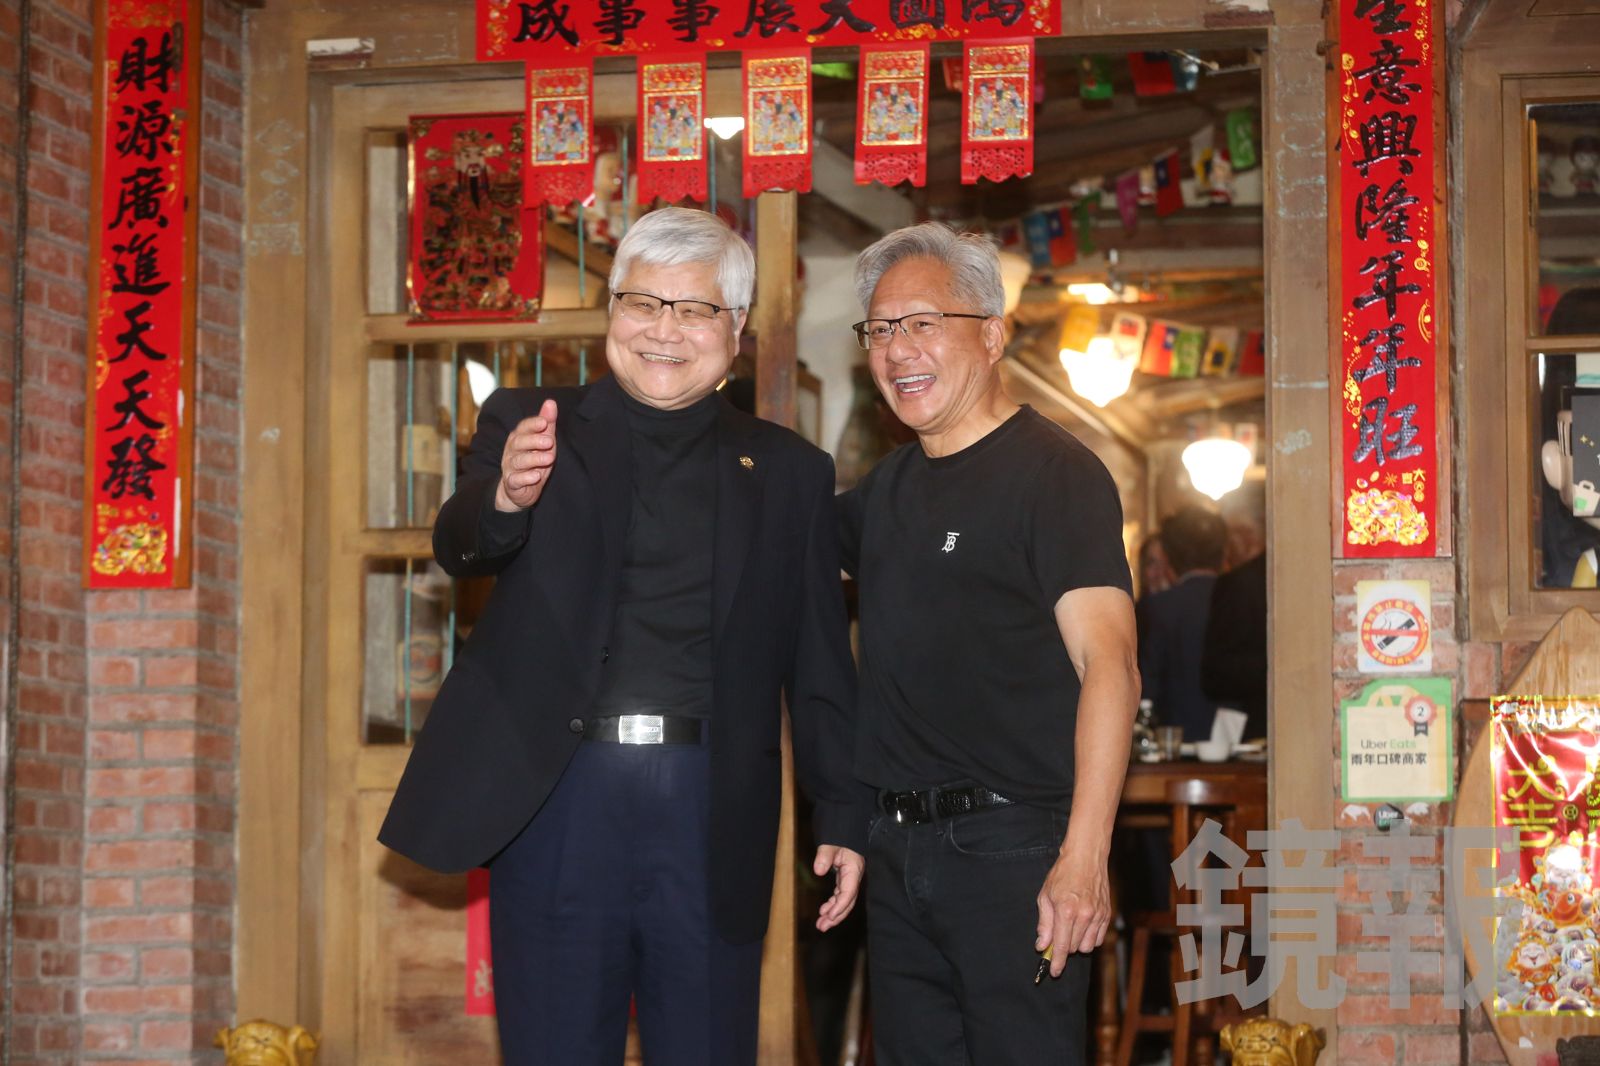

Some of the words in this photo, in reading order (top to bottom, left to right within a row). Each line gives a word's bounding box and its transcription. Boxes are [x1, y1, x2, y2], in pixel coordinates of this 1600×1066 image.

[105, 31, 174, 500] 財源廣進天天發
[1417, 706, 1424, 717] 2
[1360, 739, 1387, 750] Uber
[1390, 739, 1416, 750] Eats
